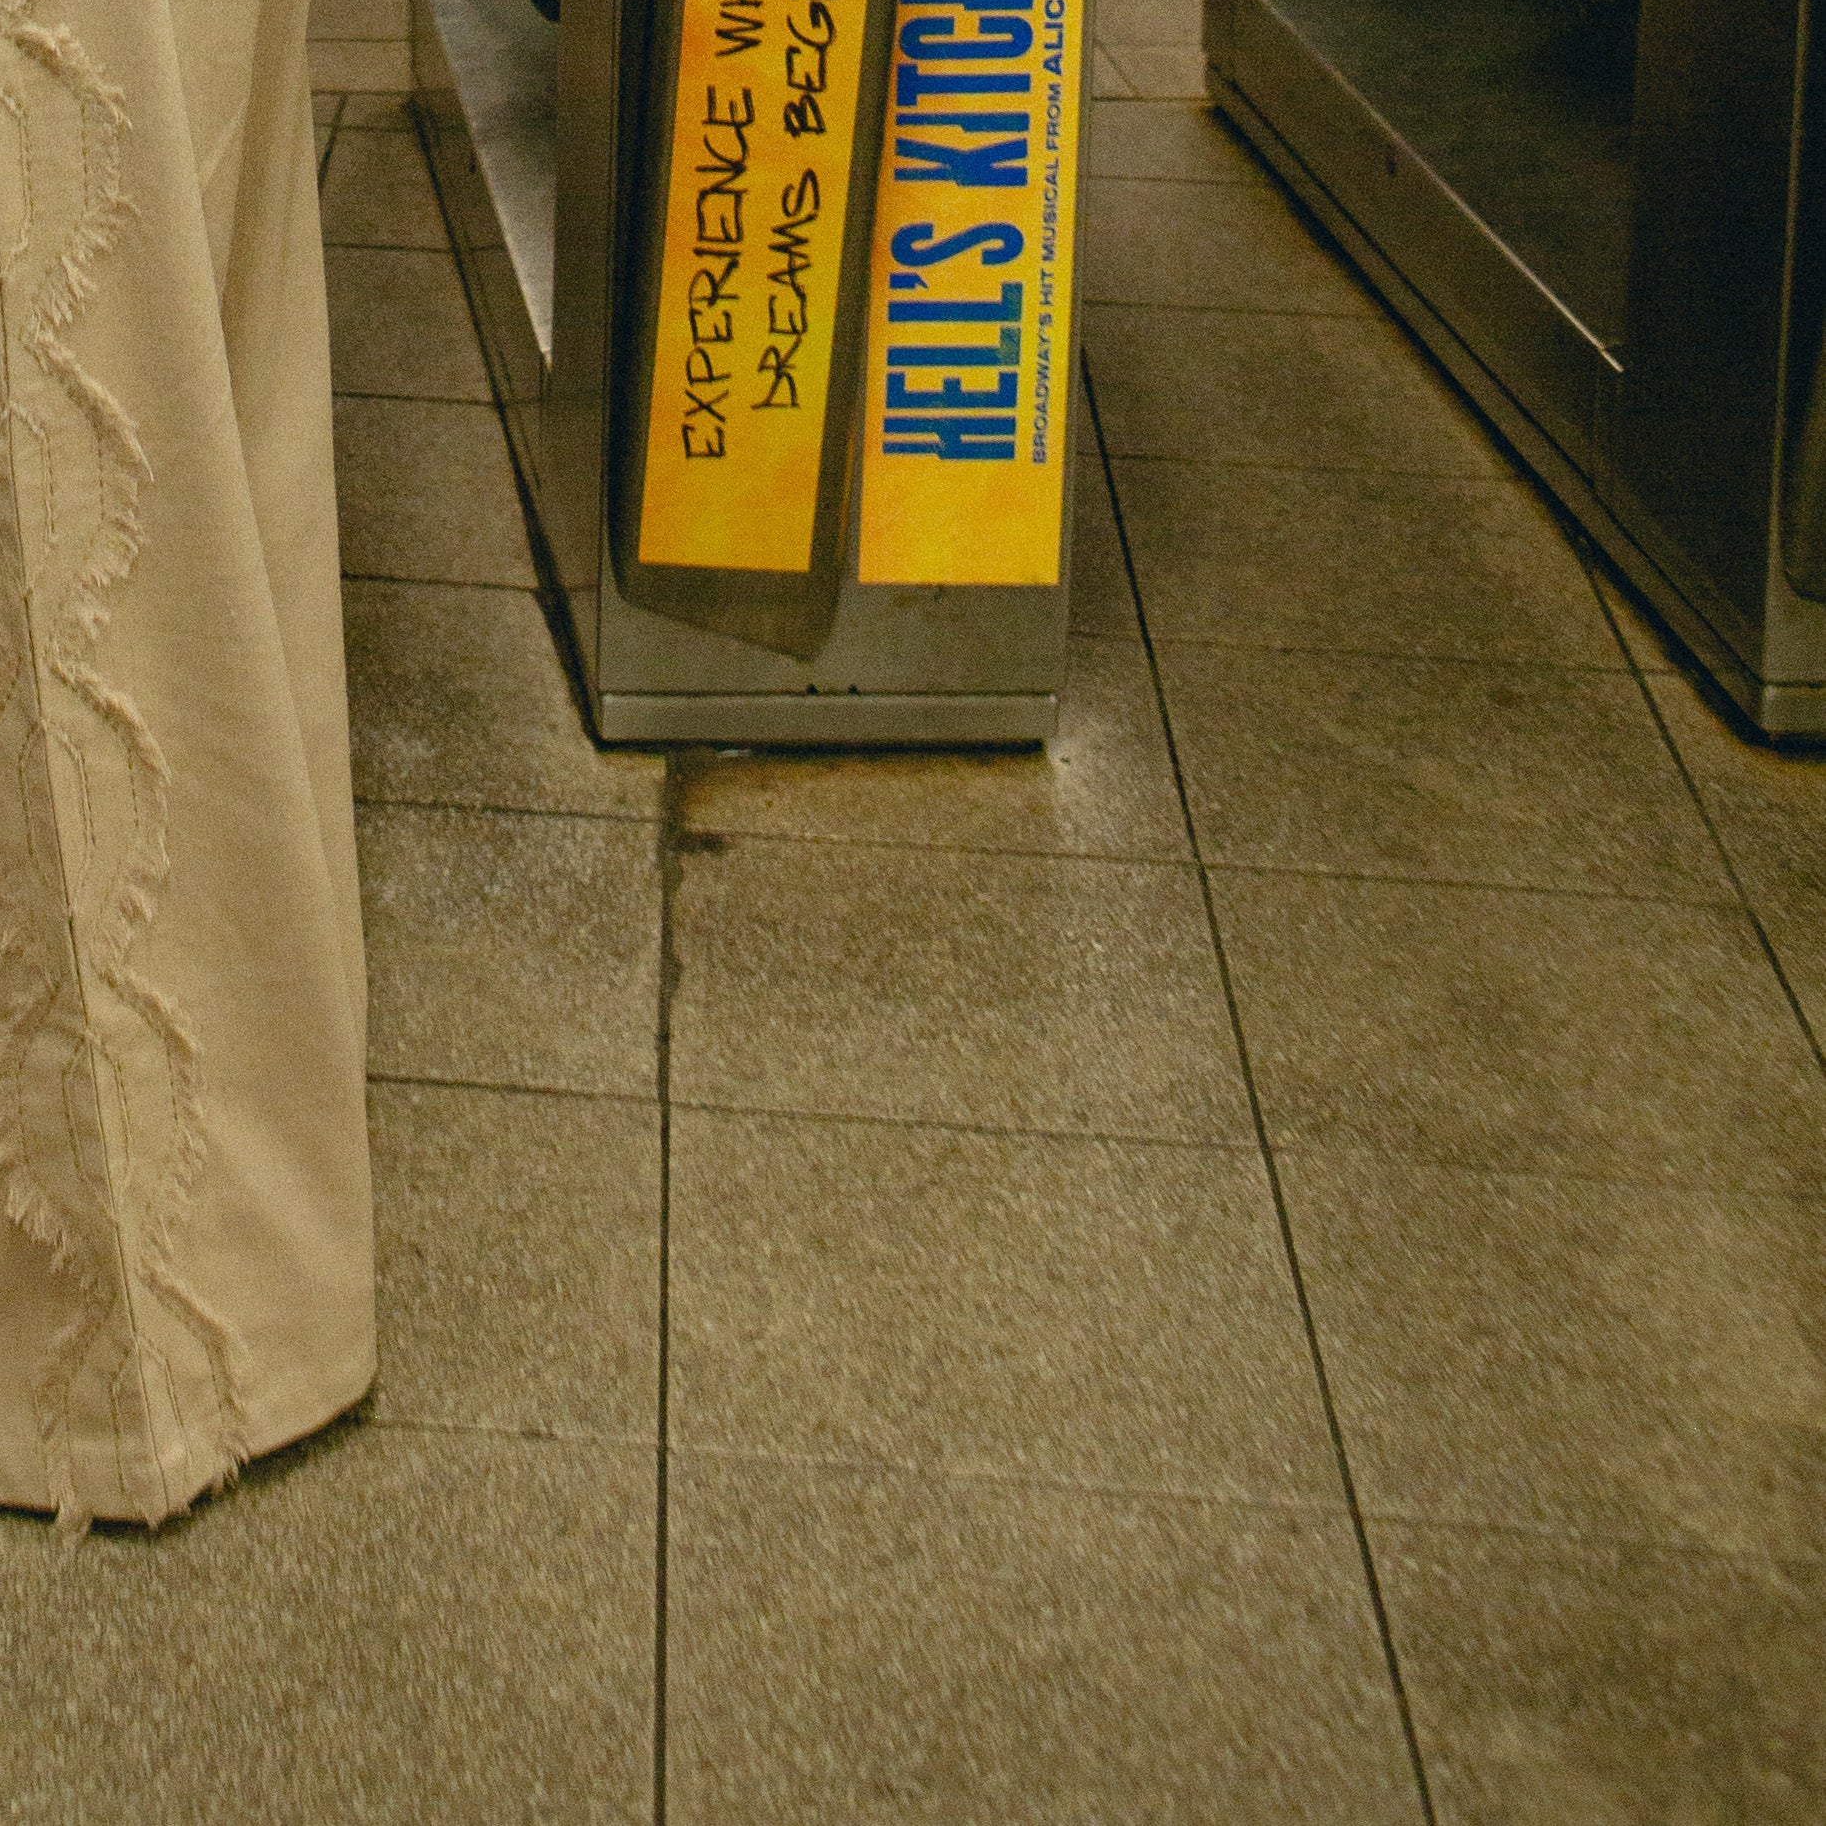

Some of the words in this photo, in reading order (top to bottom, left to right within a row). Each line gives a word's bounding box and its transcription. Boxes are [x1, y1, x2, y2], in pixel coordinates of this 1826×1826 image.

[1046, 83, 1062, 151] FROM
[681, 85, 755, 460] EXPERIENCE
[1043, 158, 1059, 262] MUSICAL
[752, 168, 821, 410] DREAMS
[882, 222, 1024, 461] HELL'S
[1040, 269, 1055, 306] HIT
[1031, 312, 1053, 465] BROADWAY'S
